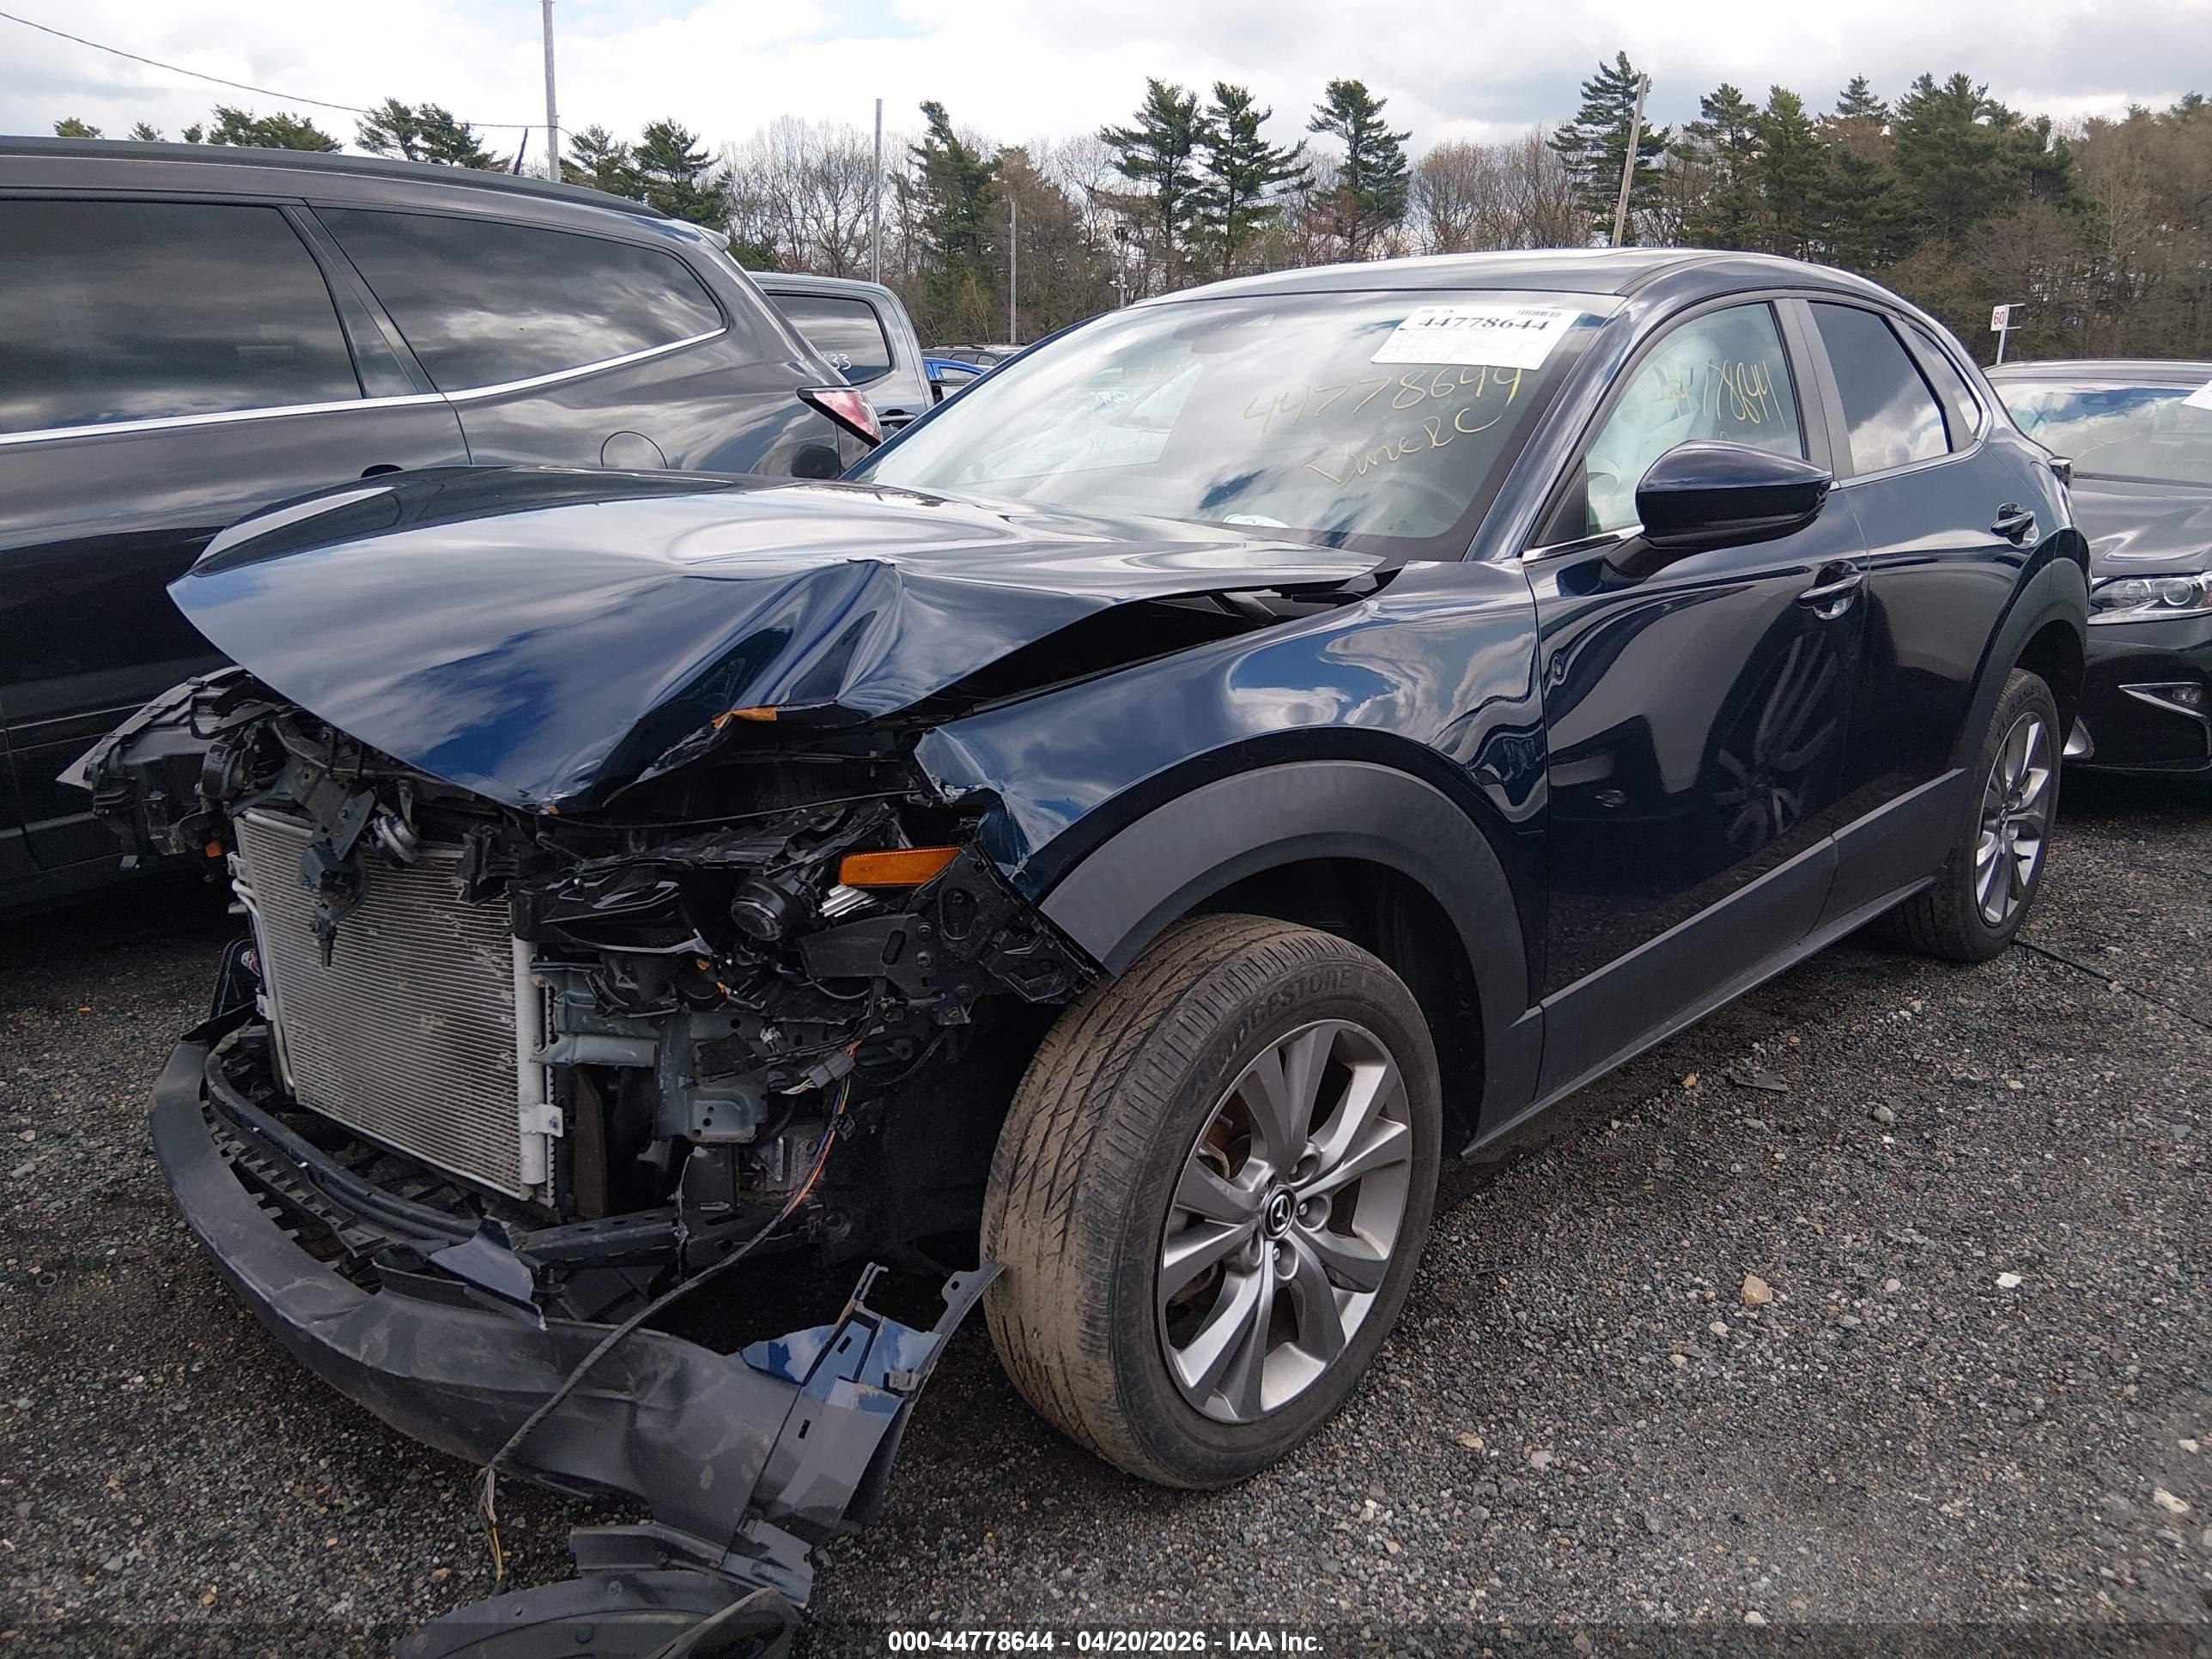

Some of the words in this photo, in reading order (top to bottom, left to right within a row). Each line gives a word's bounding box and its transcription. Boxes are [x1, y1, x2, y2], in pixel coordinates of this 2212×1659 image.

[1418, 316, 1550, 331] 44778644
[1993, 311, 2005, 325] 60
[1243, 367, 1522, 434] 44778644
